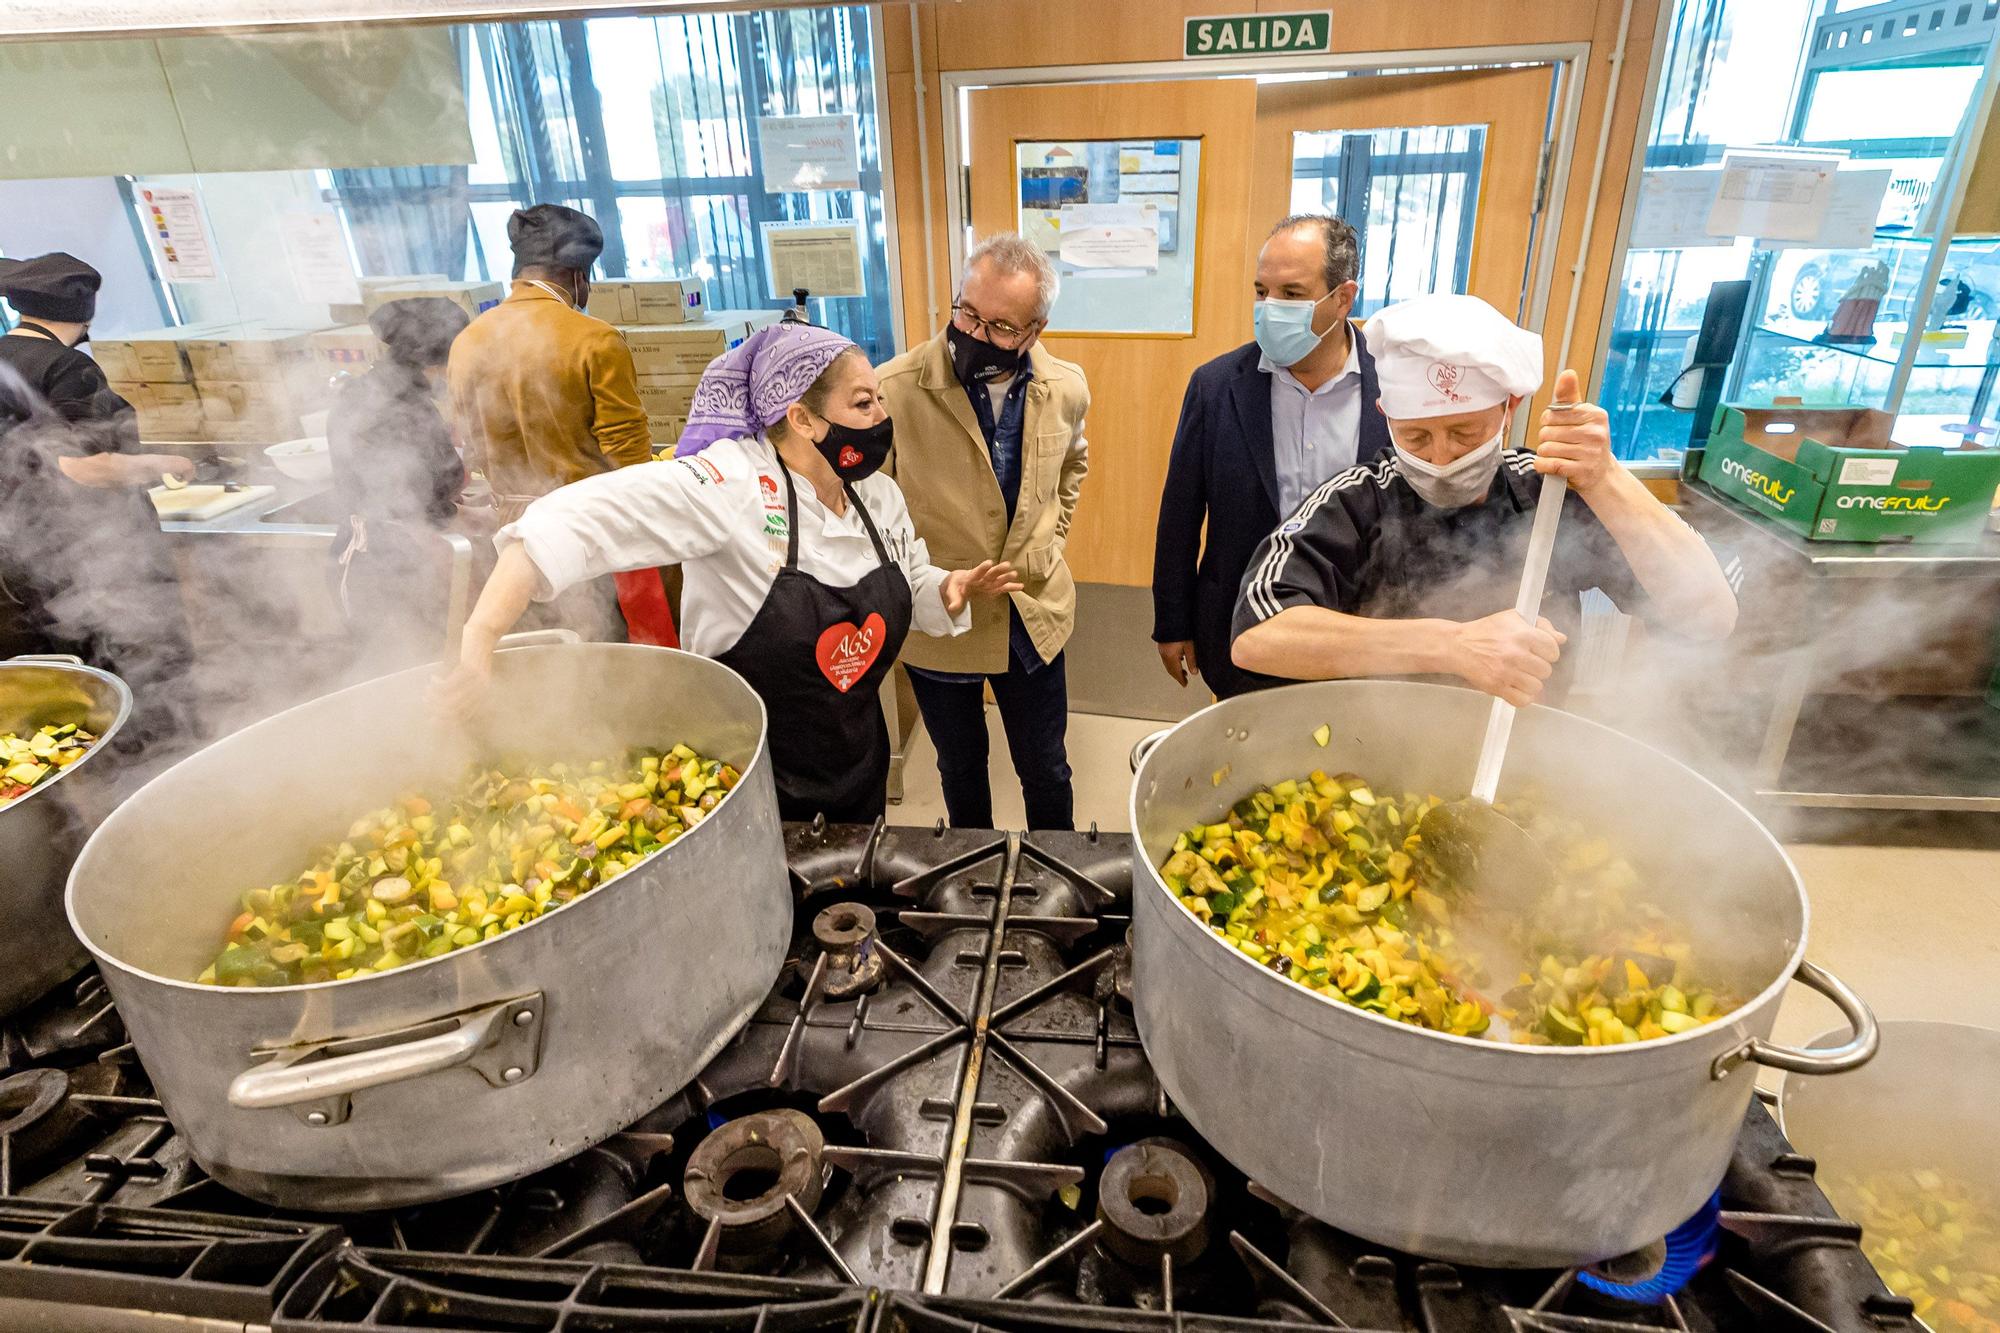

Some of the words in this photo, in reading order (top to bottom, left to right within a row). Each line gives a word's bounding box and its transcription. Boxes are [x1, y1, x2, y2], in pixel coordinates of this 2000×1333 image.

[1197, 18, 1316, 51] SALIDA
[1436, 366, 1457, 381] AGS
[830, 627, 873, 661] AGS
